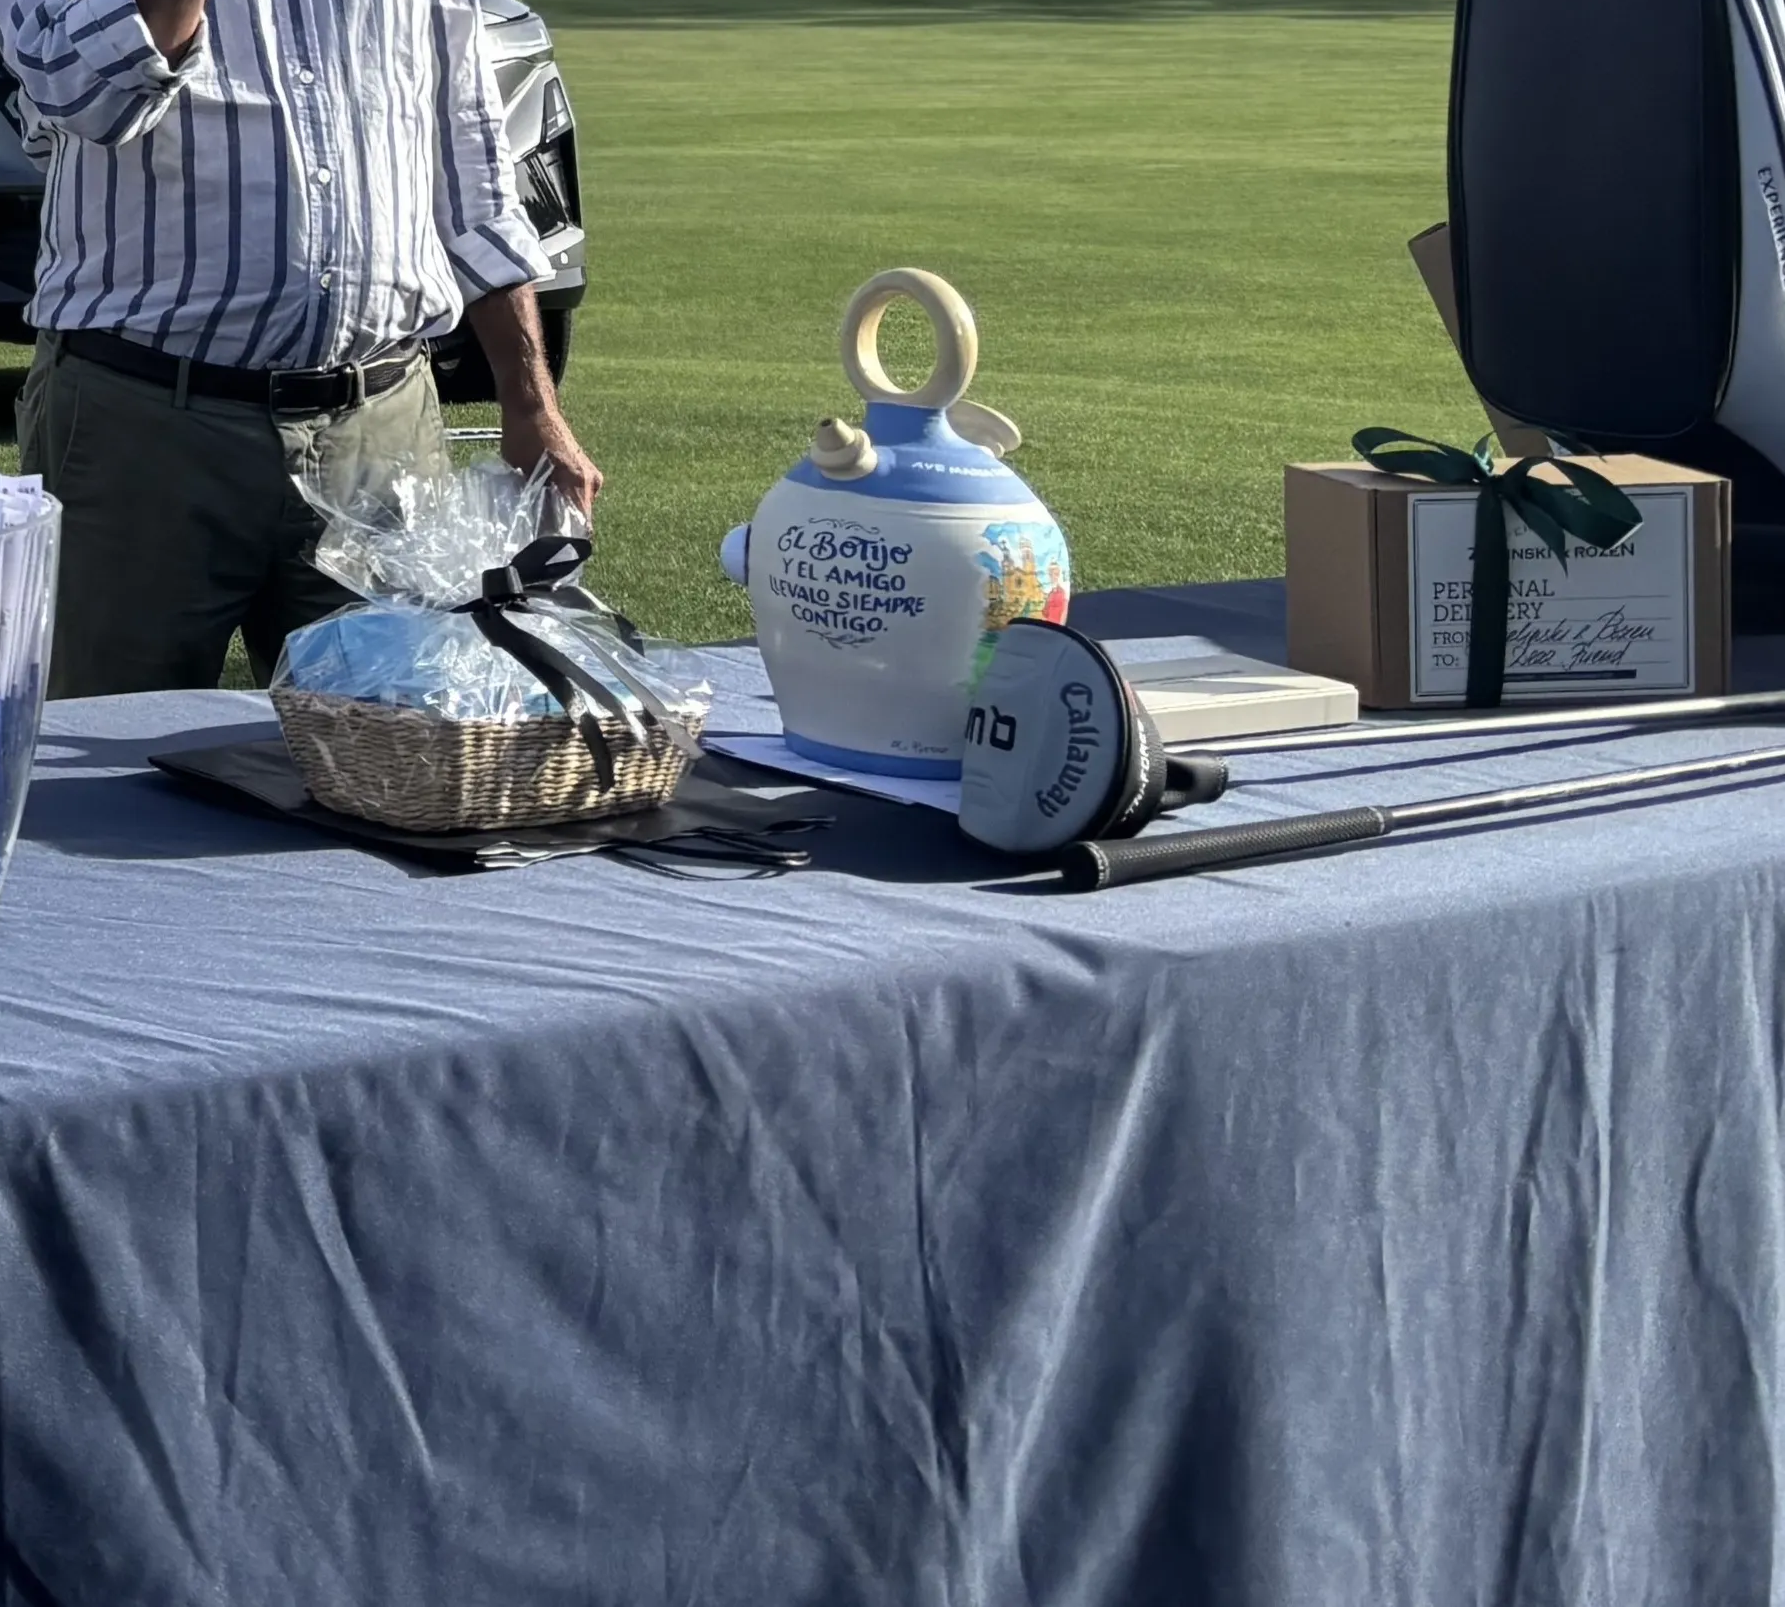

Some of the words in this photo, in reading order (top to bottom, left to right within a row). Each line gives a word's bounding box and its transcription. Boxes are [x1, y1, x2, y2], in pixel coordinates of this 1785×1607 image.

[781, 557, 794, 576] Y
[797, 561, 819, 583] EL
[825, 565, 907, 592] AMIGO
[1432, 578, 1556, 601] PERNAL
[769, 574, 831, 607] LLEVALO
[835, 591, 927, 618] SIEMPRE
[1433, 601, 1545, 623] DELERY
[791, 603, 889, 635] CONTIGO.
[1433, 653, 1460, 667] TO:
[1035, 681, 1100, 819] Callaway
